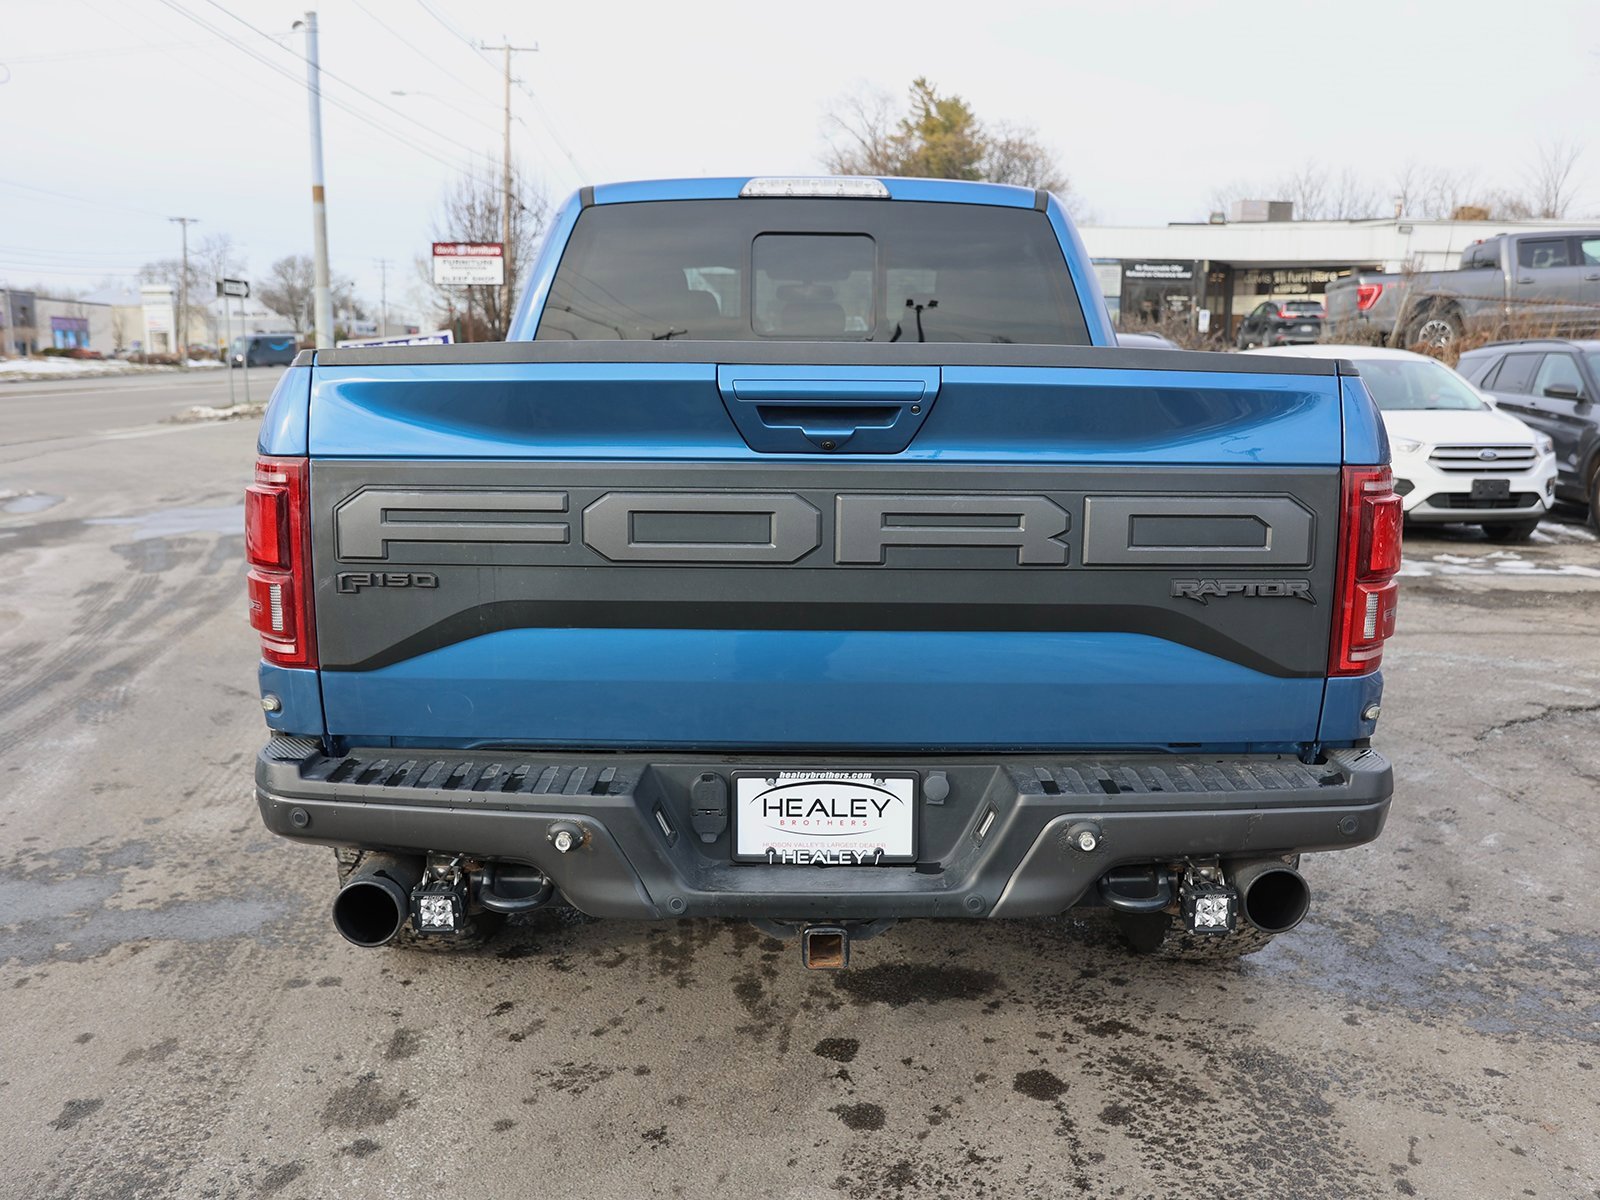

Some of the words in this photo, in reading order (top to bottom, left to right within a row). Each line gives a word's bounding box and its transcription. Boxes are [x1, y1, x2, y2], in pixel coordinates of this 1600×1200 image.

[336, 487, 1314, 568] FORD
[1171, 578, 1317, 605] RAPTOR
[779, 771, 872, 780] healeybrothers.com
[763, 798, 891, 818] HEALEY
[781, 849, 867, 865] HEALEY
